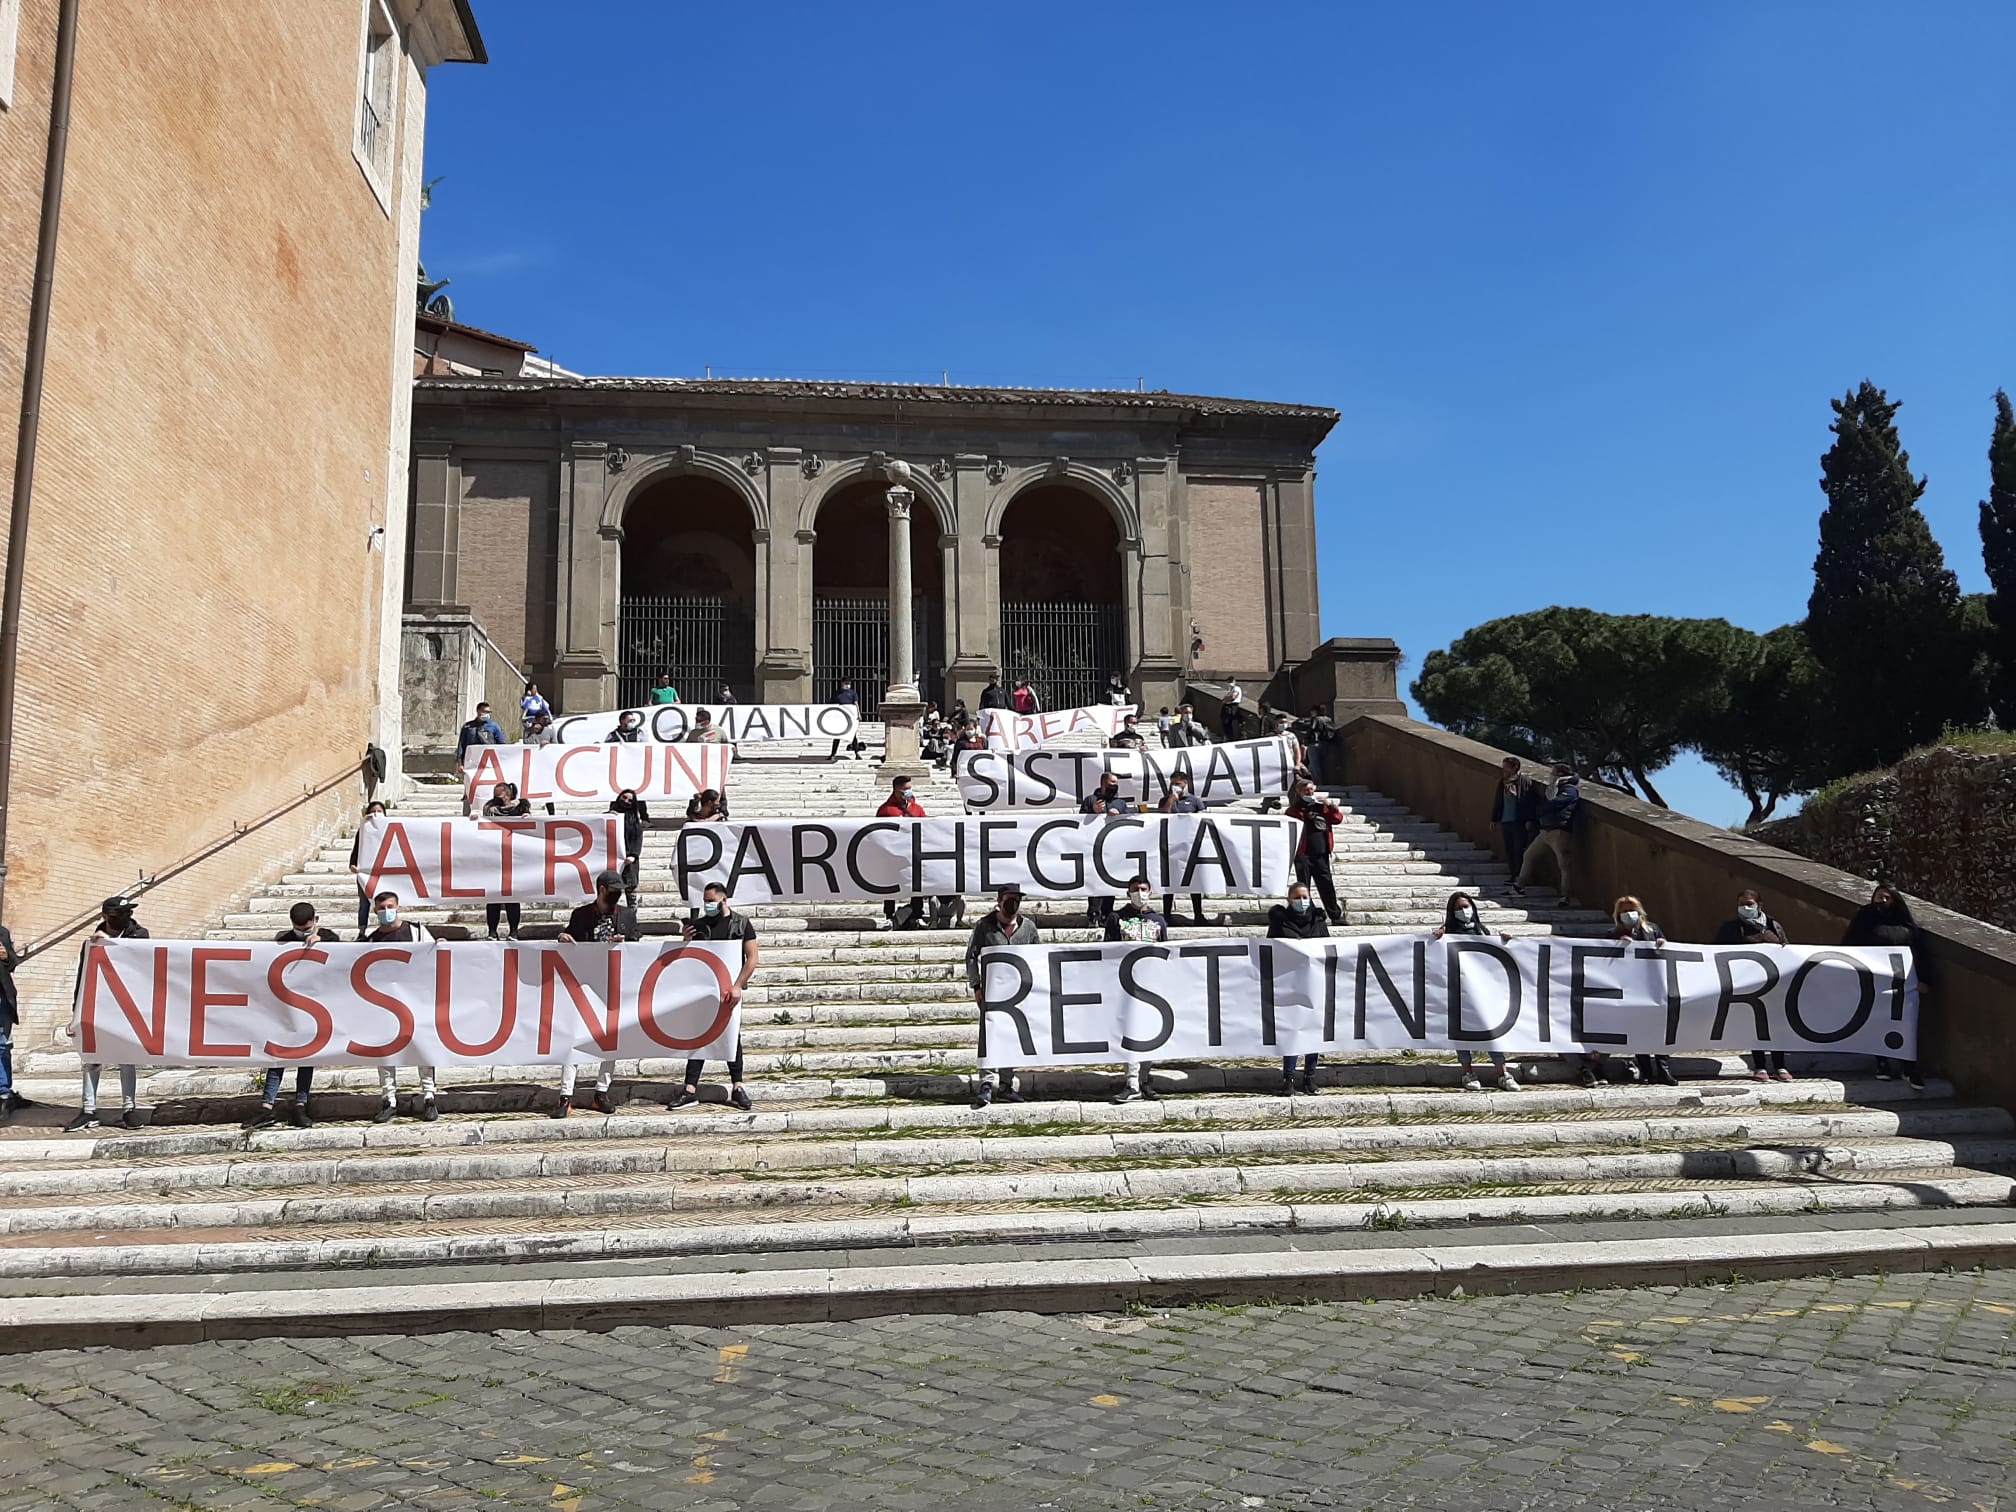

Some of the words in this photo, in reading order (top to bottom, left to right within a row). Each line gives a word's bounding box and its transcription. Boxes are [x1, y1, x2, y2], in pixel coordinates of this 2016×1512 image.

[985, 707, 1098, 750] AREA
[469, 745, 728, 805] ALCUNI
[966, 740, 1288, 807] SISTEMATI
[365, 820, 617, 898] ALTRI
[677, 818, 1298, 901] PARCHEGGIATI
[81, 945, 733, 1057] NESSUNO
[978, 944, 1276, 1058] RESTI
[1322, 941, 1906, 1050] INDIETRO!
